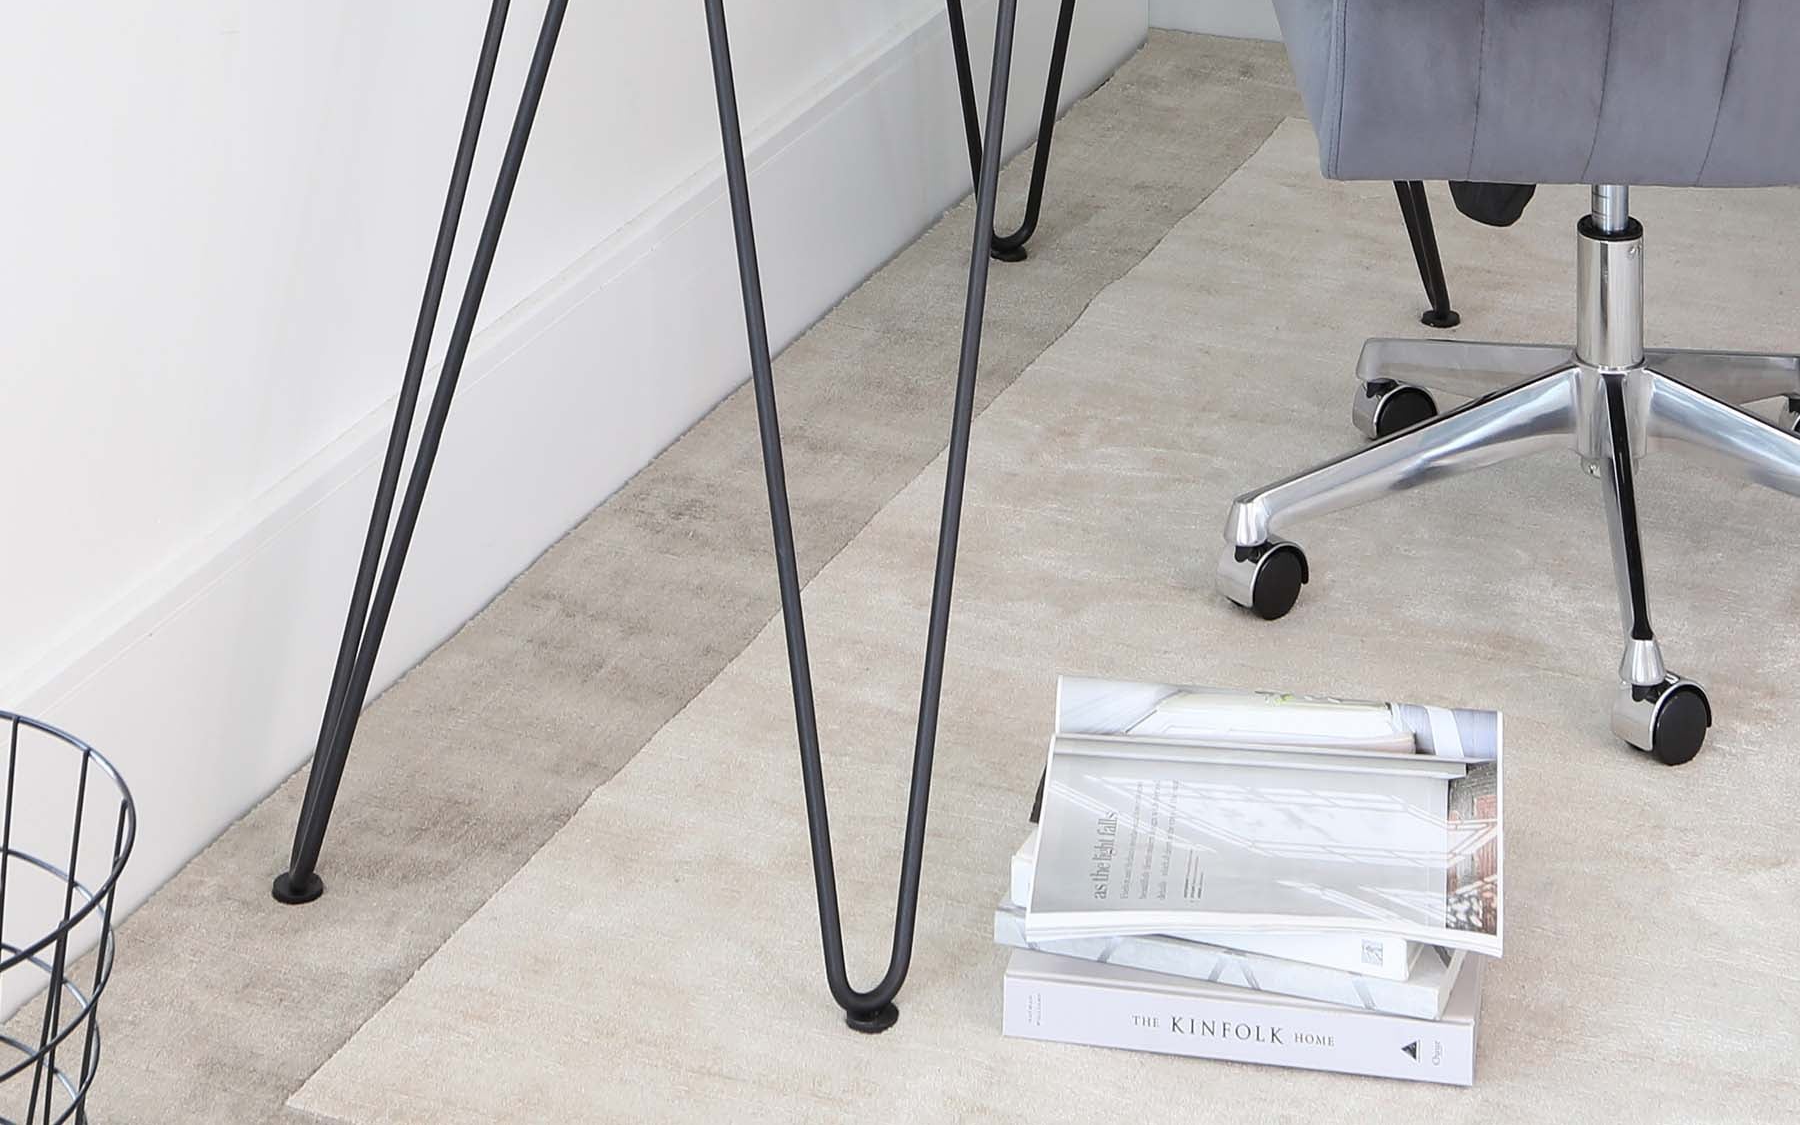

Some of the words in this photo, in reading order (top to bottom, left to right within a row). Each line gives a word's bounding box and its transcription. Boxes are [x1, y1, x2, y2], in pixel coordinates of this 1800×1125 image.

[1096, 811, 1118, 836] falls
[1092, 838, 1119, 861] light
[1089, 862, 1111, 882] the
[1094, 883, 1107, 900] as
[1131, 1015, 1160, 1028] THE
[1171, 1016, 1284, 1045] KINFOLK
[1294, 1032, 1336, 1047] HOME
